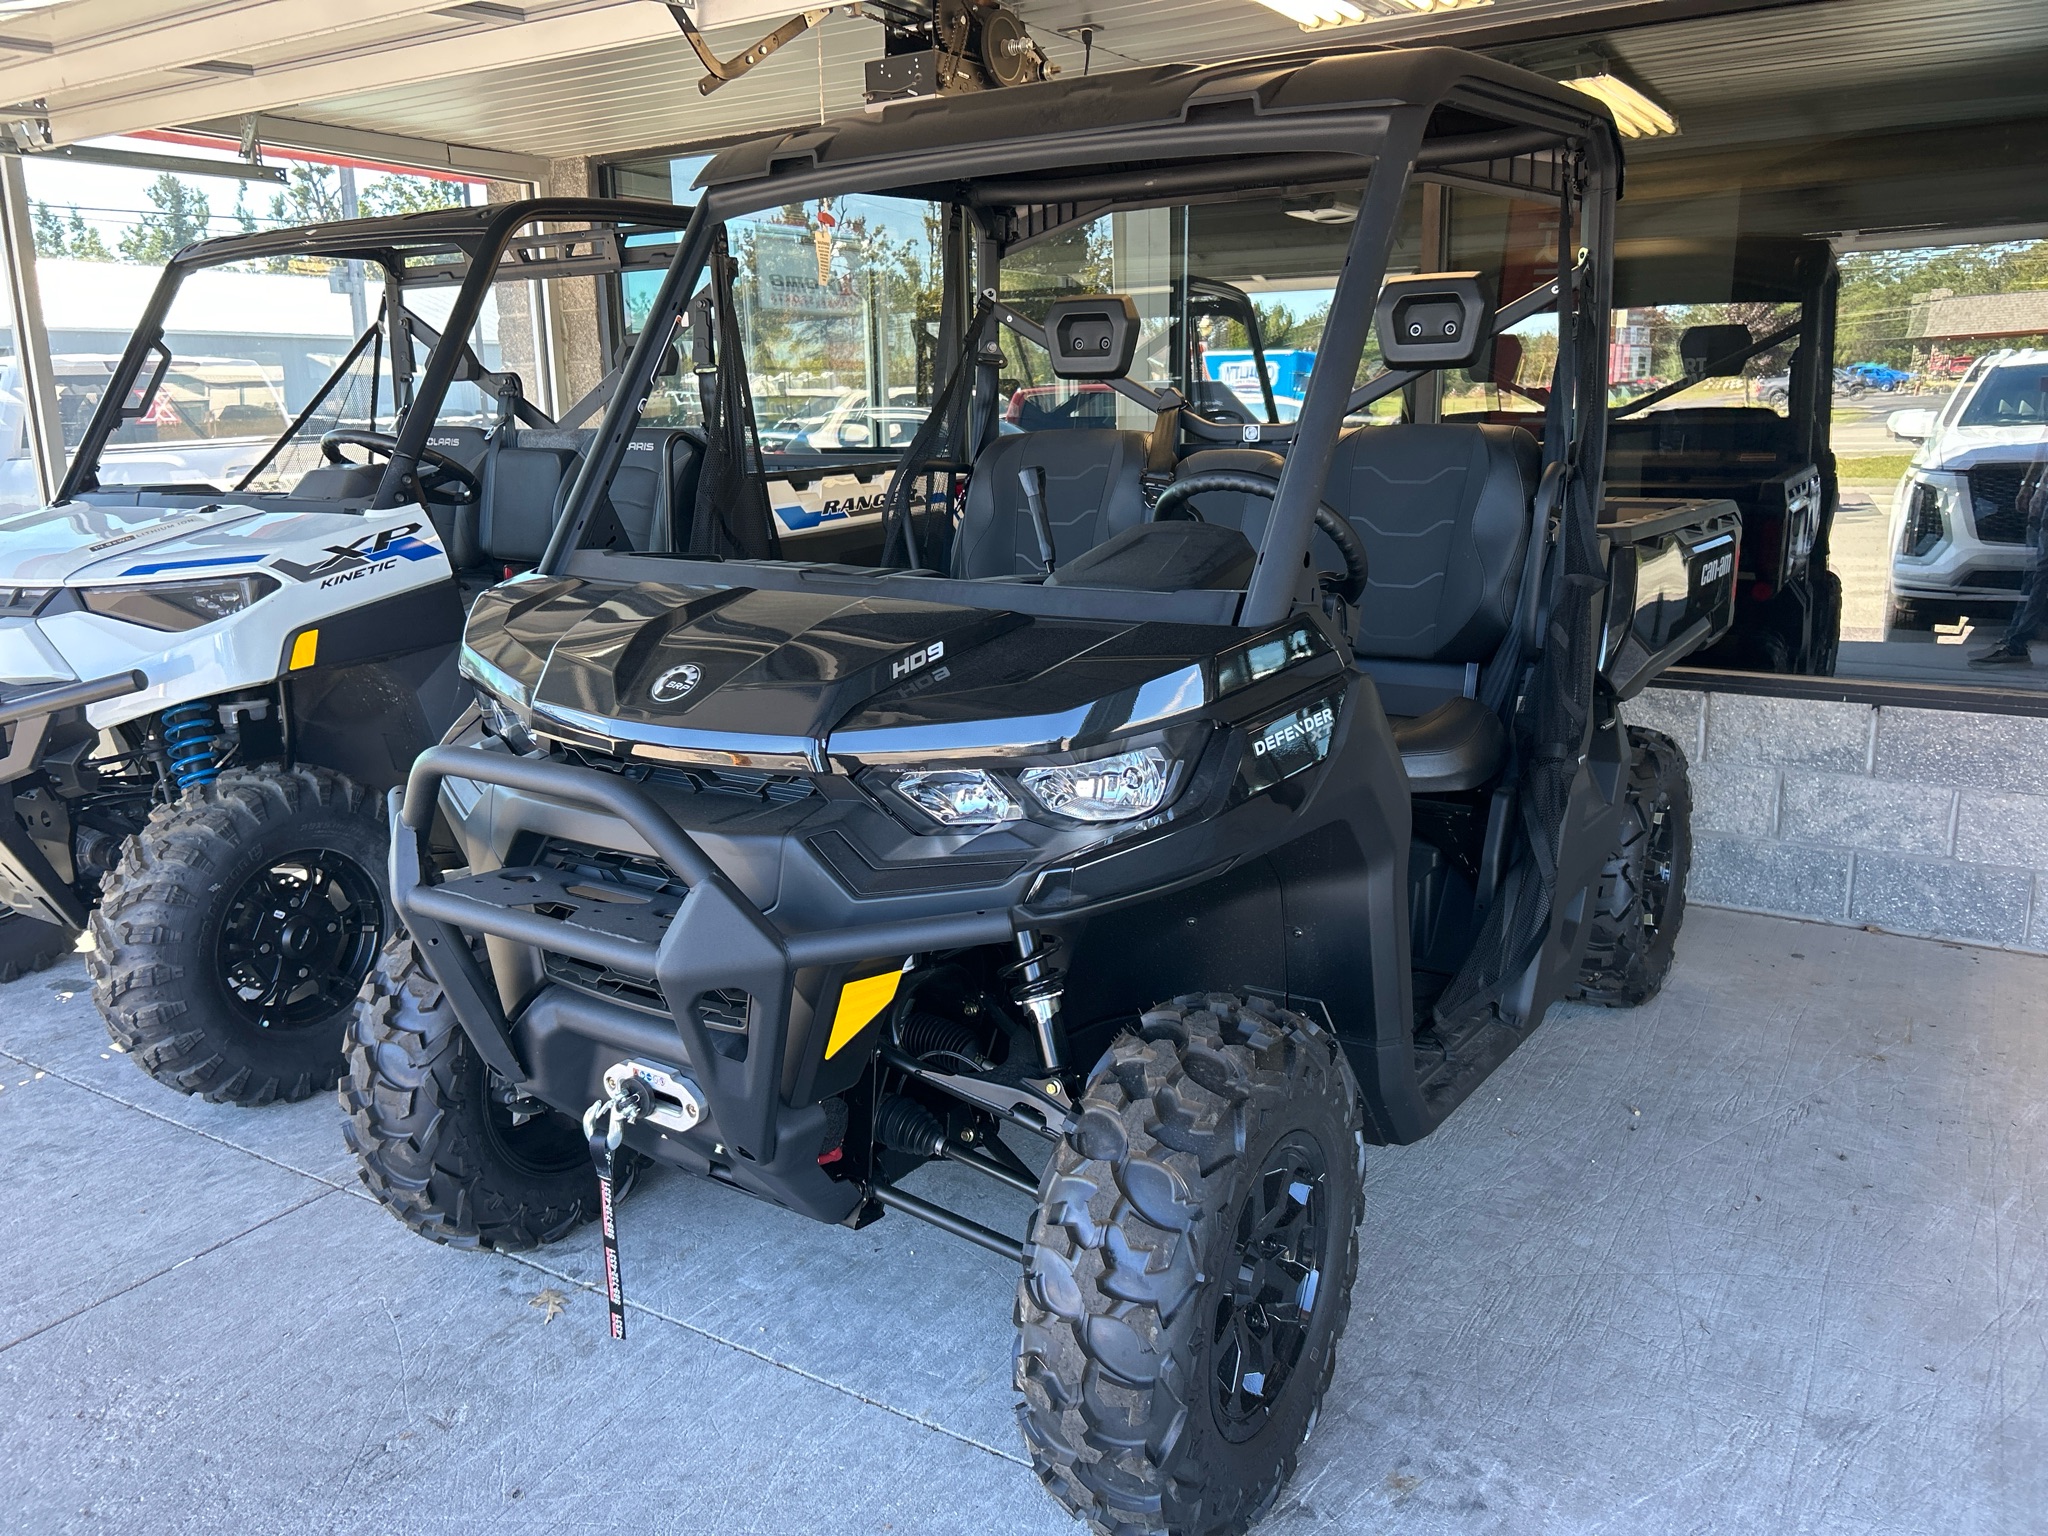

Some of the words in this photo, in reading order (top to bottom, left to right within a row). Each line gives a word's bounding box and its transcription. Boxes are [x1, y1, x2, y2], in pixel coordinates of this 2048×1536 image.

[427, 438, 460, 447] OLARIS
[626, 442, 654, 451] ARIS
[136, 524, 175, 538] LITHIUM
[178, 518, 195, 526] ION
[310, 522, 423, 573] XP
[320, 559, 398, 590] KINETIC
[892, 640, 944, 680] HD9
[665, 680, 691, 691] BRP
[1254, 708, 1334, 757] DEFENDER
